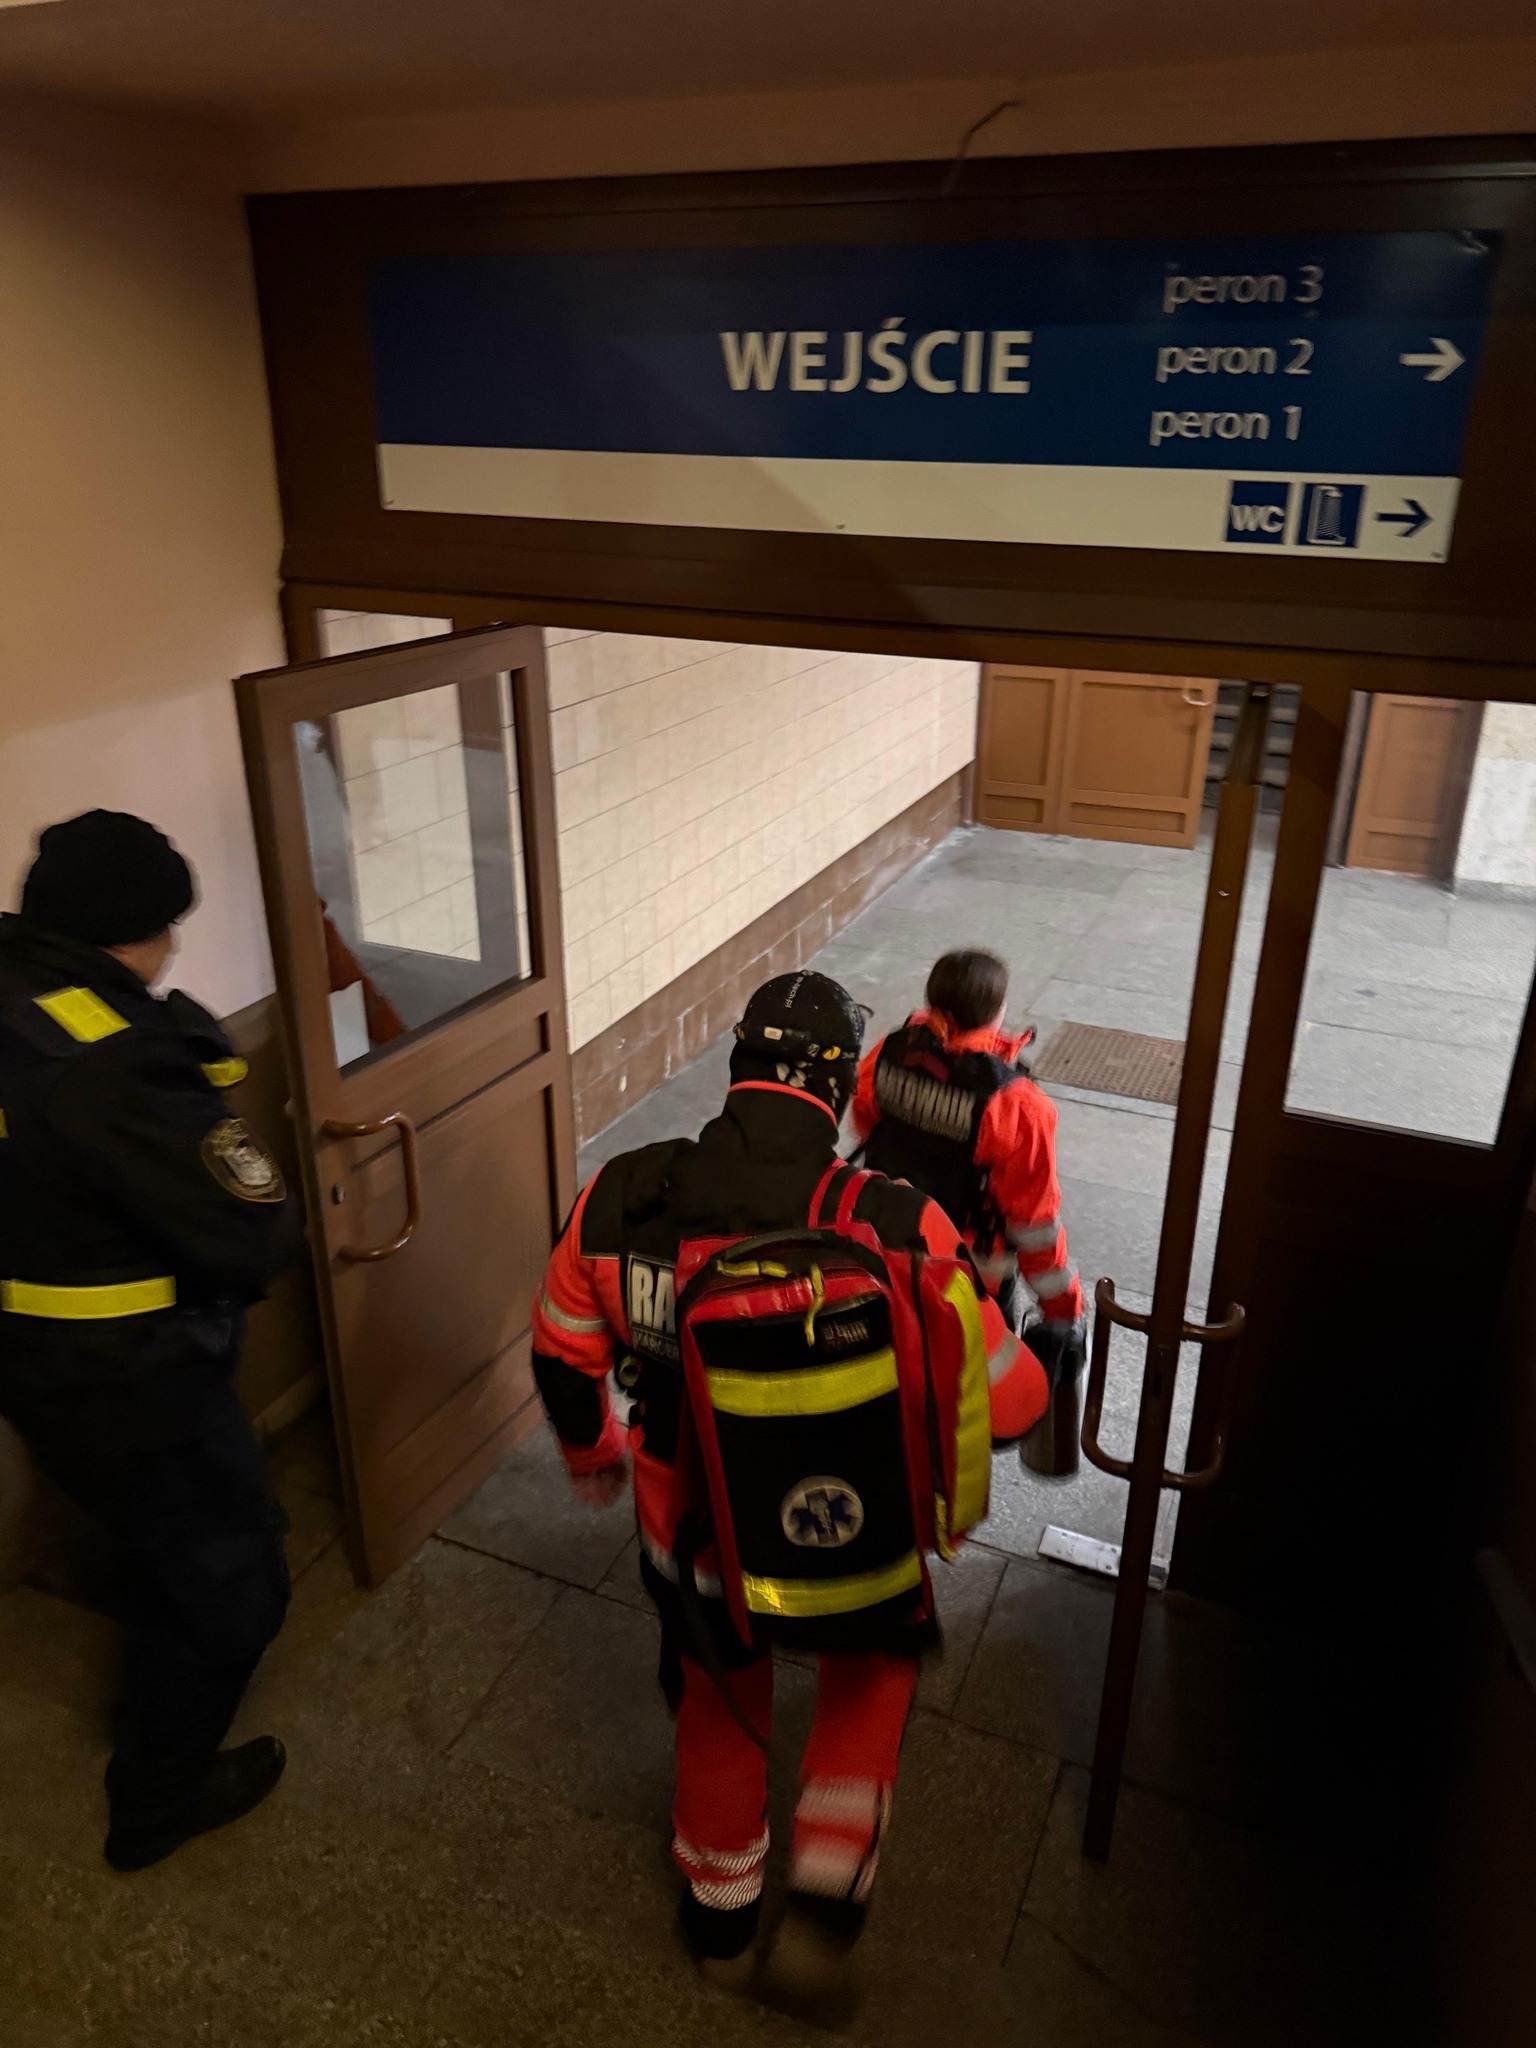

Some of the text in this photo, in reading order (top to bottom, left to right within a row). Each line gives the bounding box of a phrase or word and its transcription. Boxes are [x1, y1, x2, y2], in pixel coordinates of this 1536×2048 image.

[1162, 264, 1325, 314] peron 3
[719, 316, 1034, 394] WEJŚCIE
[1154, 337, 1316, 384] peron 2
[1148, 404, 1303, 447] peron 1
[1229, 504, 1287, 534] WC
